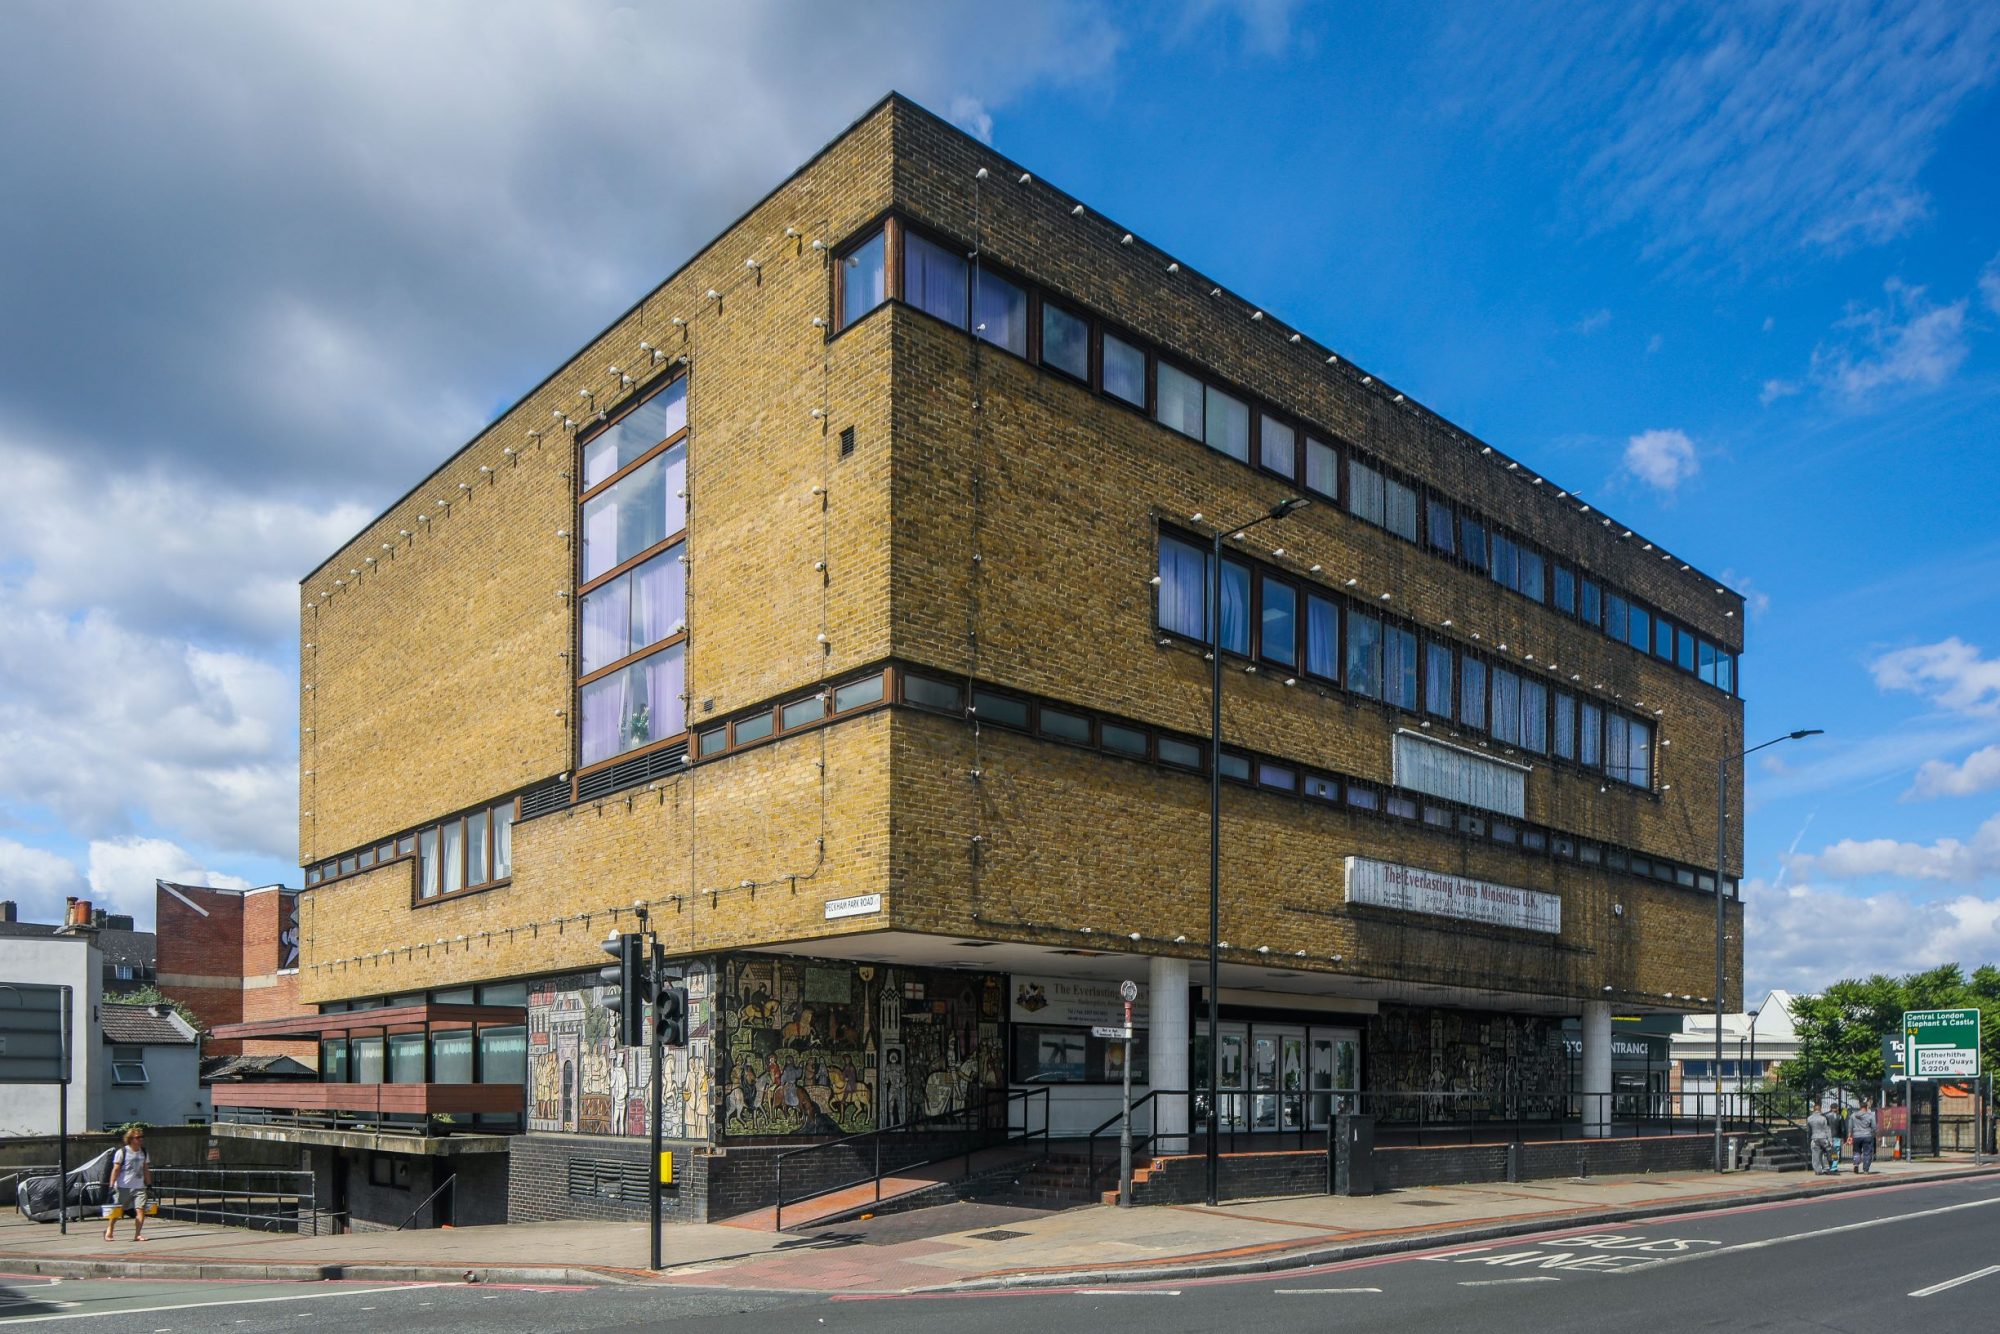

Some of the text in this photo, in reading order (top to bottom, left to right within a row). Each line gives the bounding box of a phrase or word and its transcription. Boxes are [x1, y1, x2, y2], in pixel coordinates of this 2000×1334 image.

[1384, 865, 1400, 884] The
[1404, 870, 1453, 898] Everlasting
[1456, 880, 1478, 898] Arms
[1481, 884, 1520, 906] Ministries
[826, 896, 873, 912] PECKHAM PARK ROAD
[1054, 983, 1071, 994] The
[1073, 985, 1120, 1001] Everlasting
[1907, 1012, 1965, 1021] Central London
[1907, 1020, 1940, 1028] Elephant
[1949, 1018, 1975, 1026] Castle
[1610, 1043, 1649, 1054] NTRANCE
[1920, 1051, 1966, 1059] Rotherhithe
[1921, 1058, 1974, 1067] Surrey Quays
[1538, 1234, 1722, 1251] BUS
[1416, 1248, 1664, 1273] LANE
